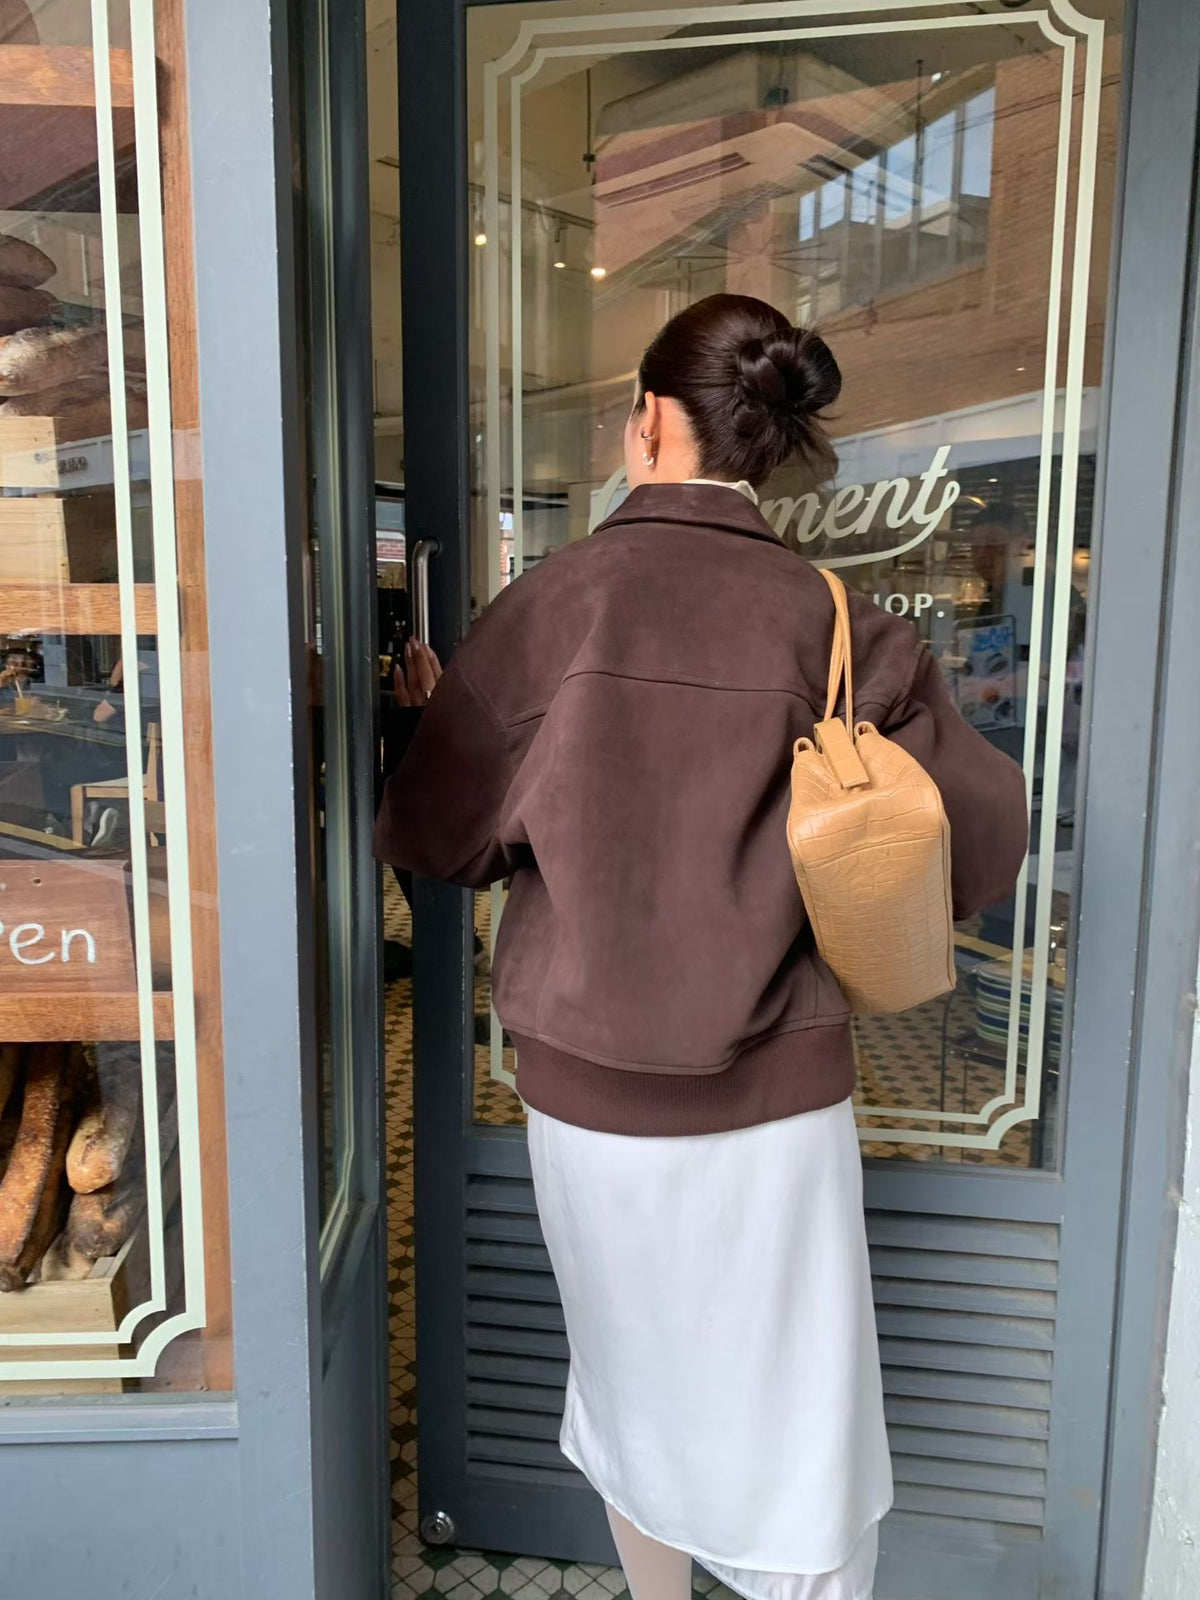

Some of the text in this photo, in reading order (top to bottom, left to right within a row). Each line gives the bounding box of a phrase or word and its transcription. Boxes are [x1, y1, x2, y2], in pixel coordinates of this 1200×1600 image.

[760, 445, 961, 569] ment
[873, 593, 945, 618] OP.
[0, 921, 96, 965] en
